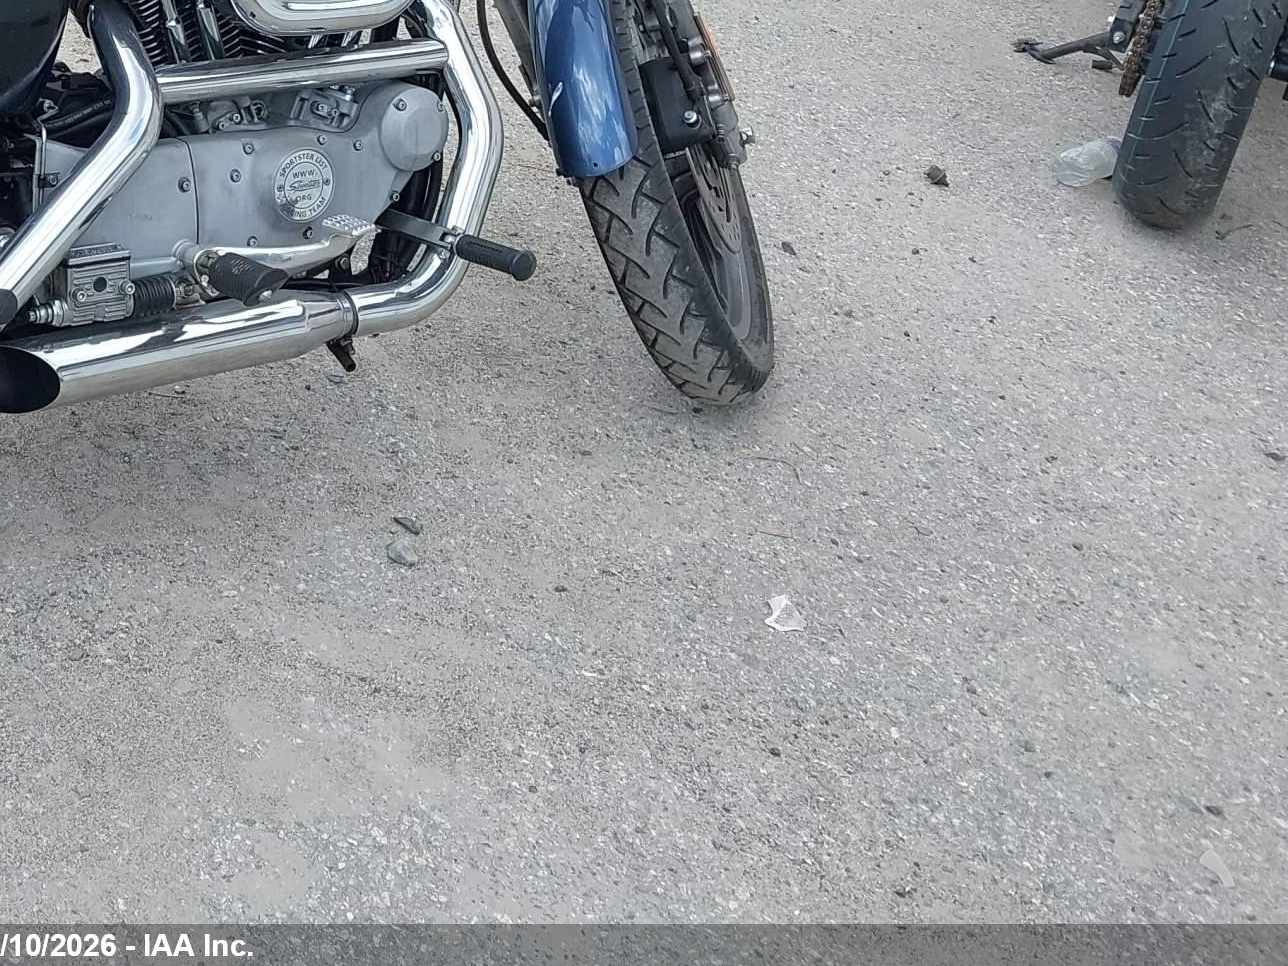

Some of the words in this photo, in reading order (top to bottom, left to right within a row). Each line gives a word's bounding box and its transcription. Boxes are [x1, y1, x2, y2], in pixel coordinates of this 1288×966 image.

[279, 153, 315, 178] SPORTSTER
[315, 156, 329, 170] LIST
[309, 196, 326, 215] TEAM
